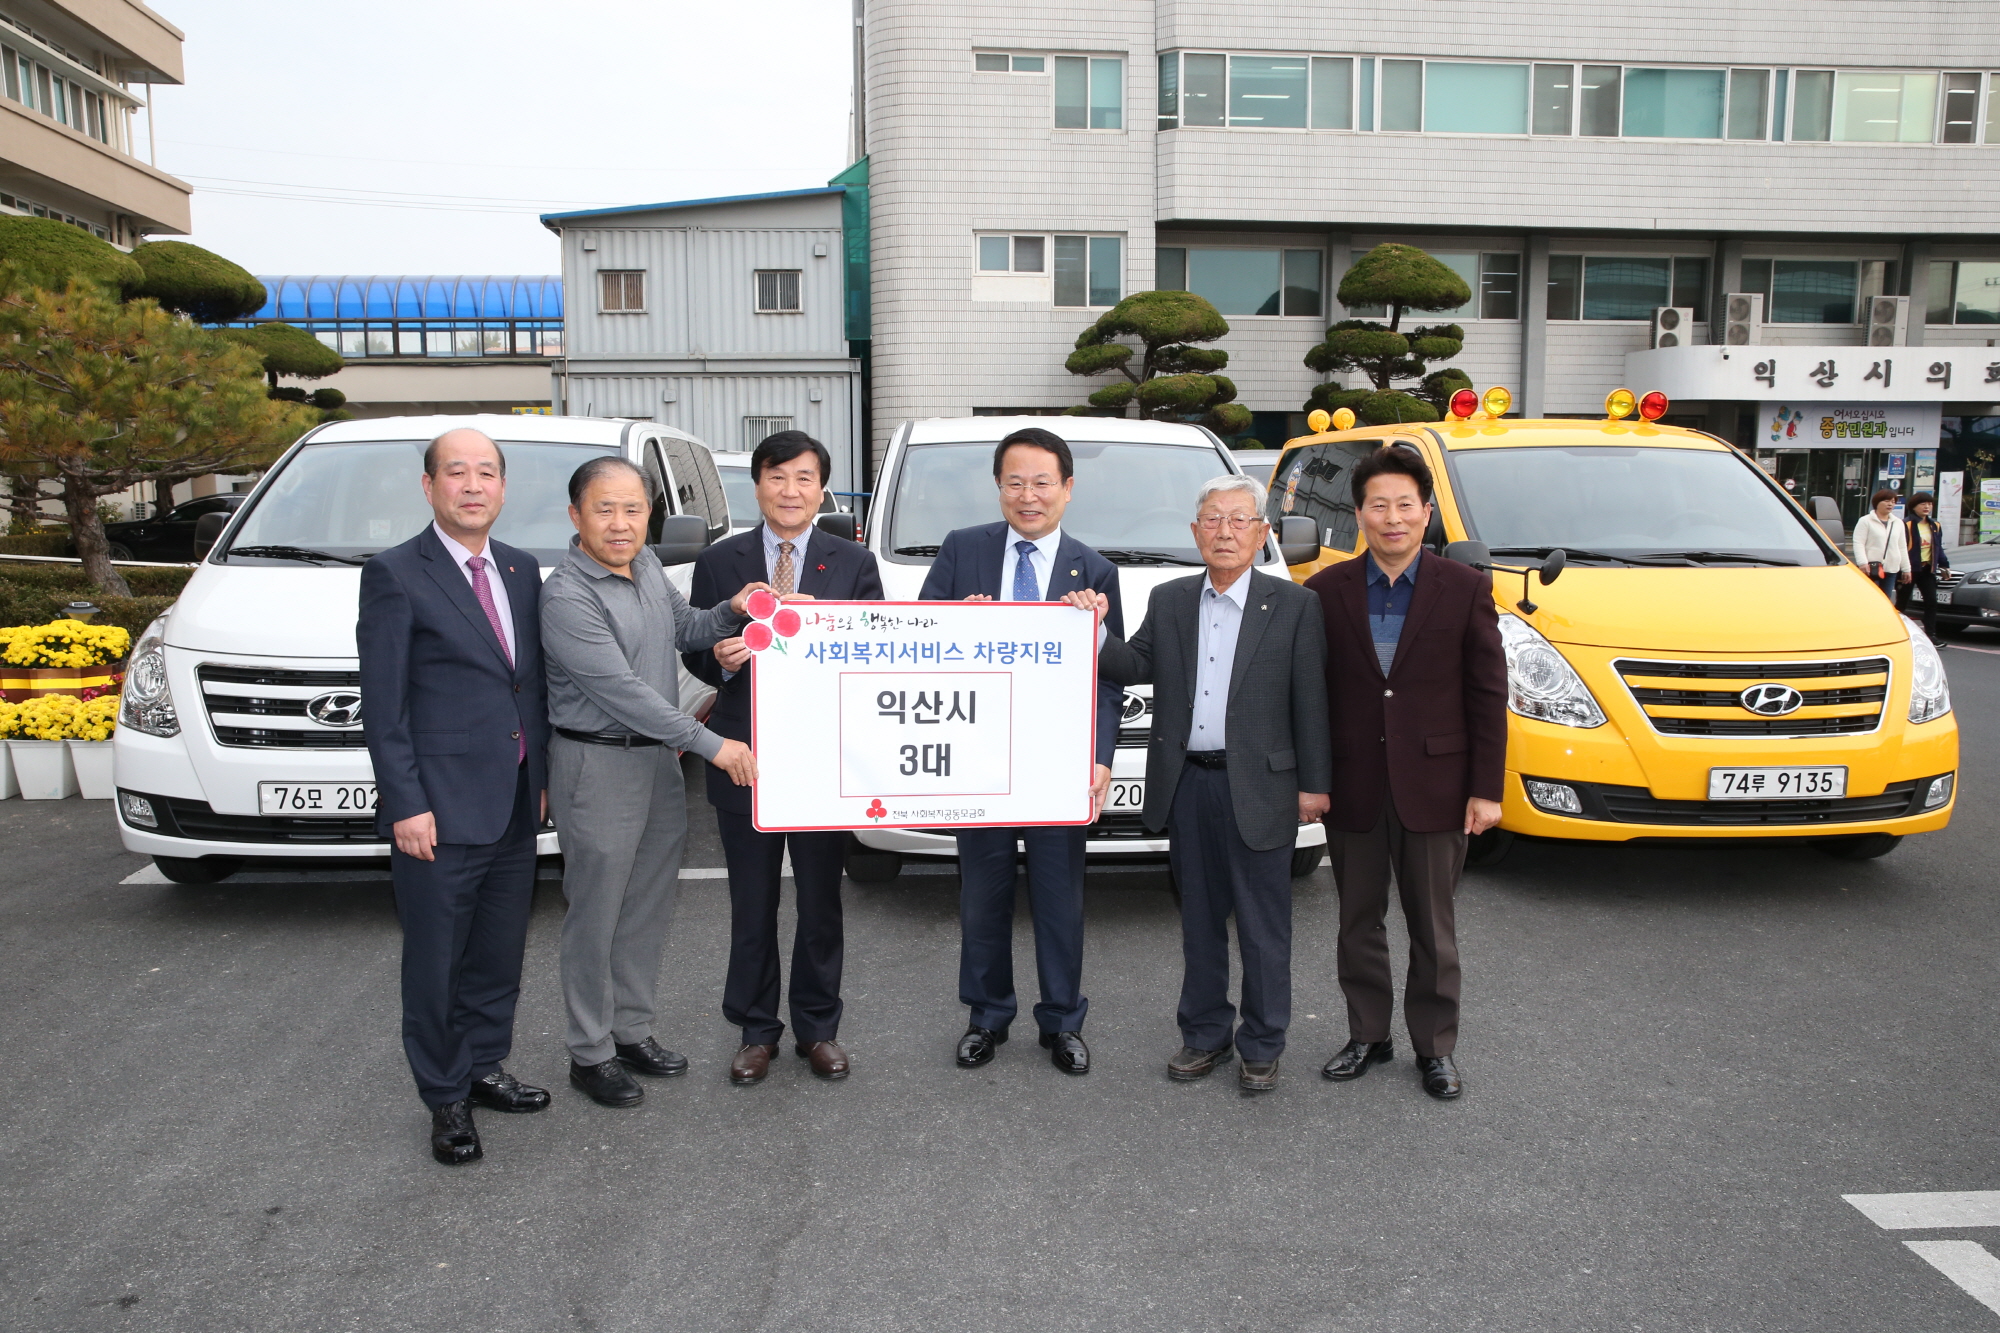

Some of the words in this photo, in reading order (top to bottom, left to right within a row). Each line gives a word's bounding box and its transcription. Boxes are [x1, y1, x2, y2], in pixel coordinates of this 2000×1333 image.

[1834, 409, 1885, 420] 어서오십시오
[805, 612, 854, 632] 나눔으로
[860, 610, 903, 633] 행복한
[907, 617, 939, 628] 나라
[804, 641, 964, 665] 사회복지서비스
[973, 641, 1063, 665] 차량지원
[876, 690, 977, 724] 익산시
[899, 743, 952, 776] 3대
[1723, 773, 1765, 793] 74루
[1778, 772, 1833, 793] 9135
[274, 787, 323, 809] 76모
[336, 787, 378, 809] 202
[1113, 784, 1142, 806] 20
[892, 810, 908, 819] 전북
[911, 808, 986, 821] 사회복지공동모금회
